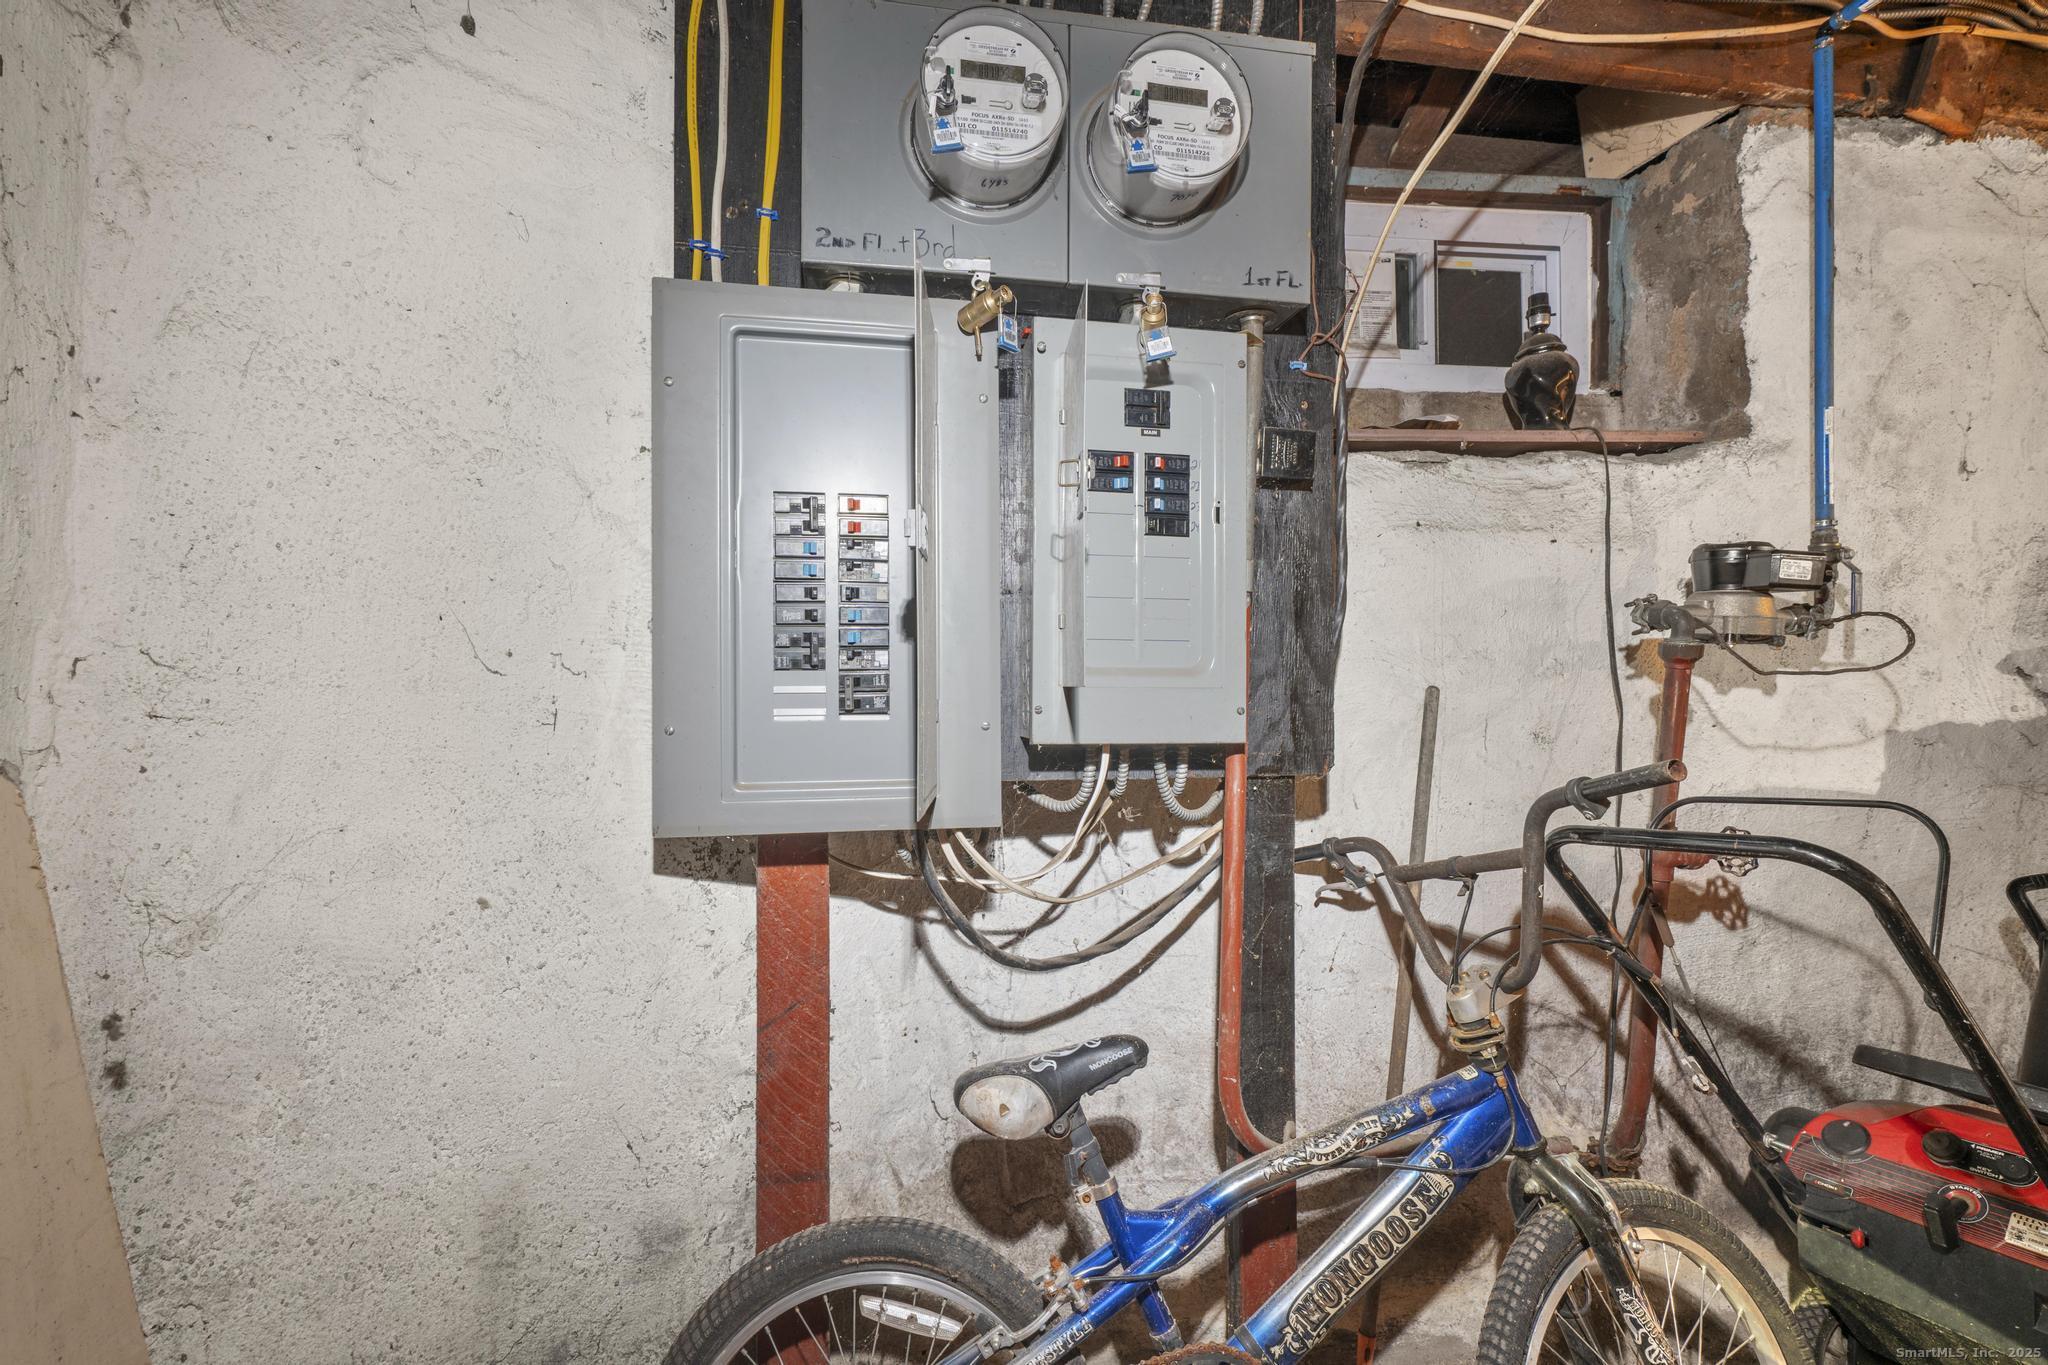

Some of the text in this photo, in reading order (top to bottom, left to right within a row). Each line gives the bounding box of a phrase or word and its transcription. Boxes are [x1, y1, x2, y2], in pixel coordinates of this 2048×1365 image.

[991, 126, 1028, 135] 011514740
[1157, 133, 1174, 141] FOCUS
[1176, 147, 1210, 156] 011514724
[1088, 1046, 1134, 1072] MONGOOSE
[1308, 1146, 1345, 1162] OUTER
[1292, 1180, 1446, 1333] MONGOOSE
